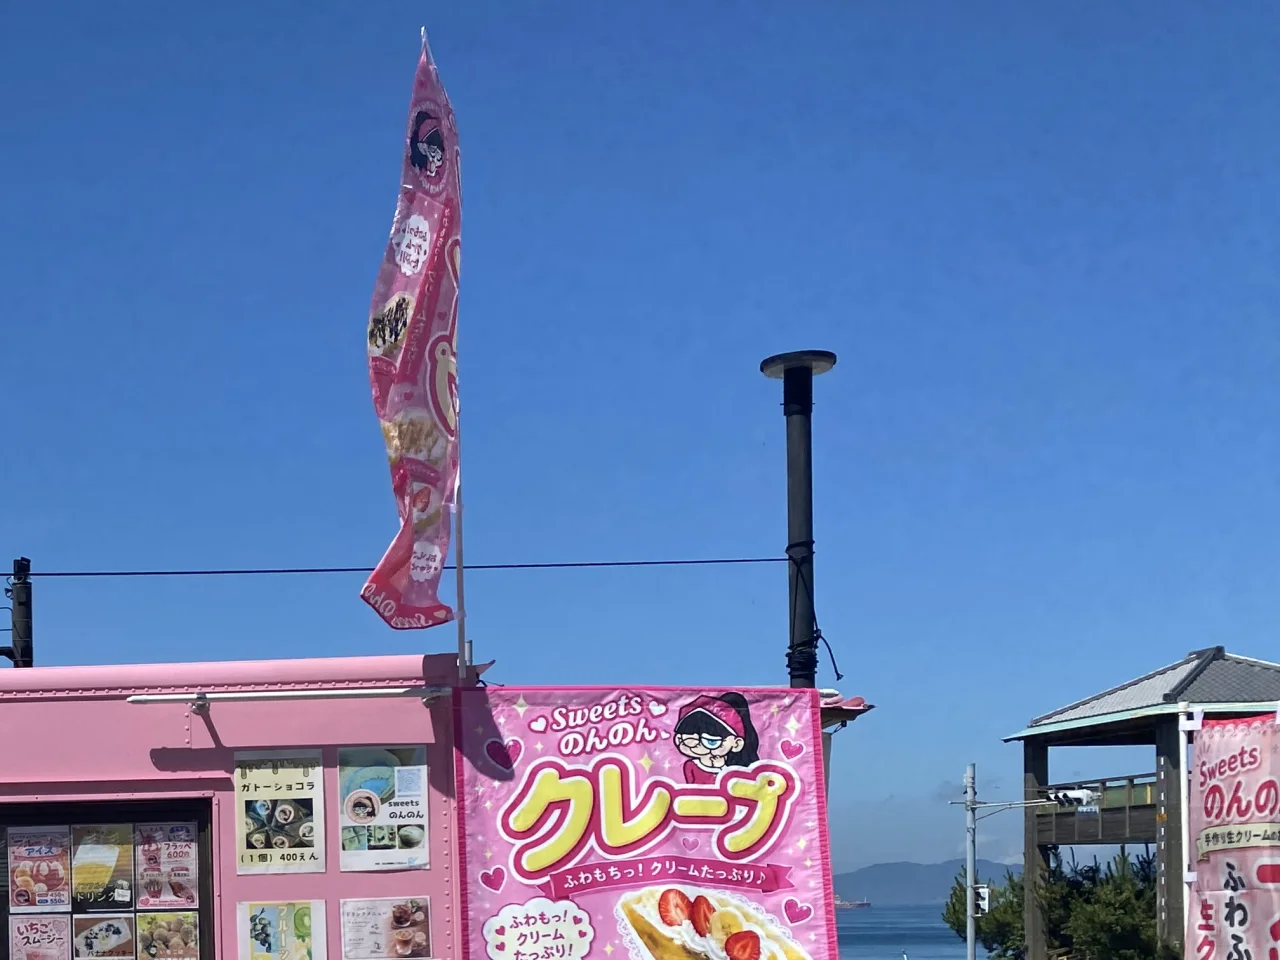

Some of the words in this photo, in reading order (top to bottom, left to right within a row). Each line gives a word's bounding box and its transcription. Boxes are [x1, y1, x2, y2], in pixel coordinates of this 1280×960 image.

[551, 696, 642, 732] Sweets
[560, 724, 657, 756] のんのん
[1200, 746, 1259, 787] Sweets
[241, 782, 315, 793] ガトーショコラ
[1204, 780, 1280, 820] のんの
[389, 812, 424, 820] のんのん
[504, 760, 795, 880] クレープ
[1205, 829, 1280, 847] 手作り生クリームの
[563, 864, 644, 888] ふわもちっ!
[17, 921, 52, 935] いちご
[509, 910, 569, 931] ふわもっ!
[21, 935, 64, 946] スムージー
[516, 928, 565, 945] クリーム
